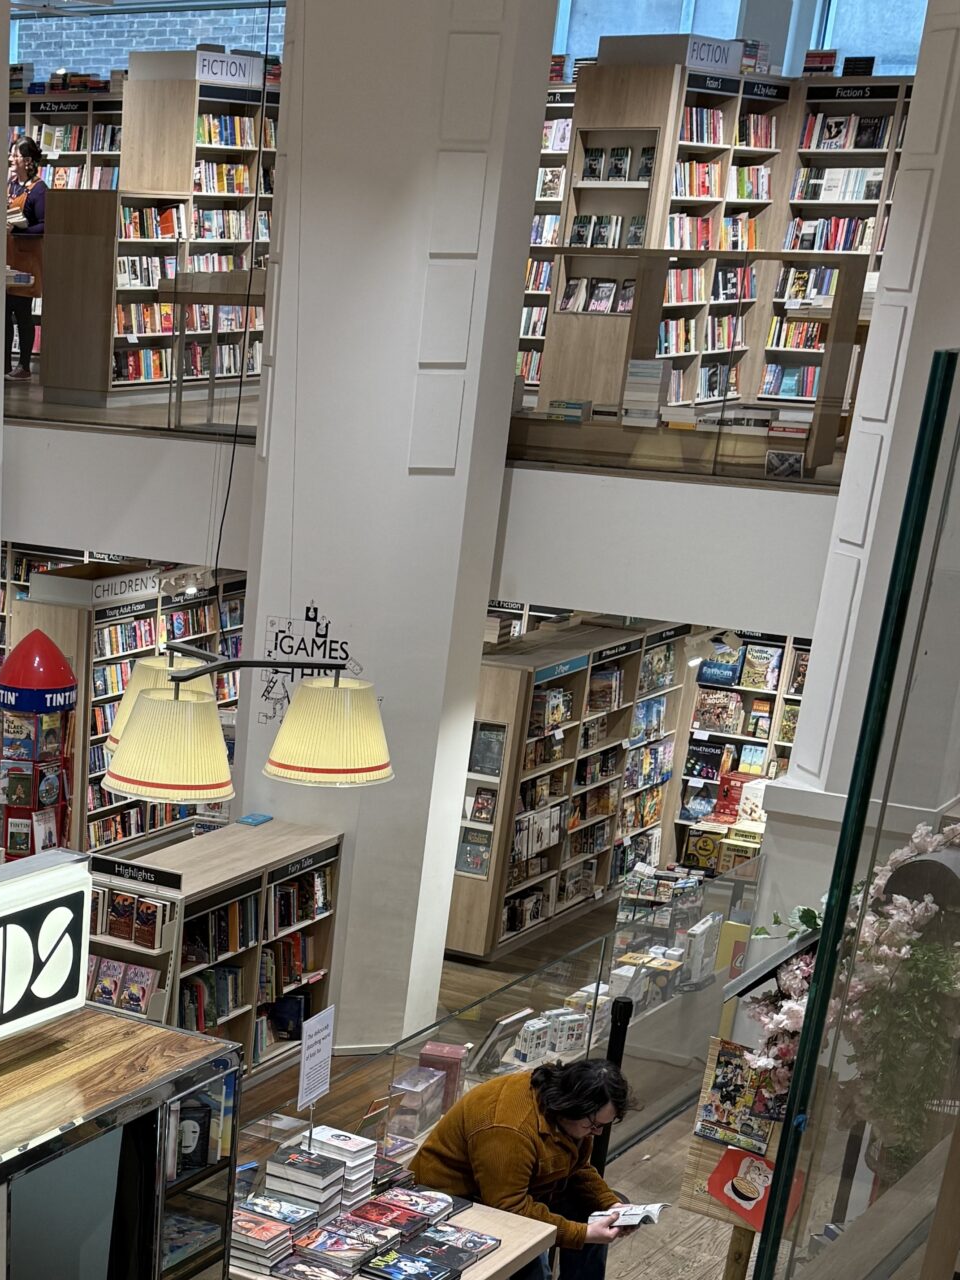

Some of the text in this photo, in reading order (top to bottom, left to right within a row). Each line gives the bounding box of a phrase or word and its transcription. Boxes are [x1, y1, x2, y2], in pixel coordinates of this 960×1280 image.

[691, 41, 730, 64] FICTION
[201, 58, 247, 78] FICTION
[836, 87, 871, 98] Fiction S
[40, 102, 79, 112] A-Z by Author
[94, 576, 157, 599] CHILDREN'S
[106, 602, 146, 618] Young Adult Fiction
[279, 635, 350, 661] GAMES
[9, 821, 30, 829] TINTIN
[115, 863, 155, 883] Highlights
[288, 857, 314, 874] Fairy Tales
